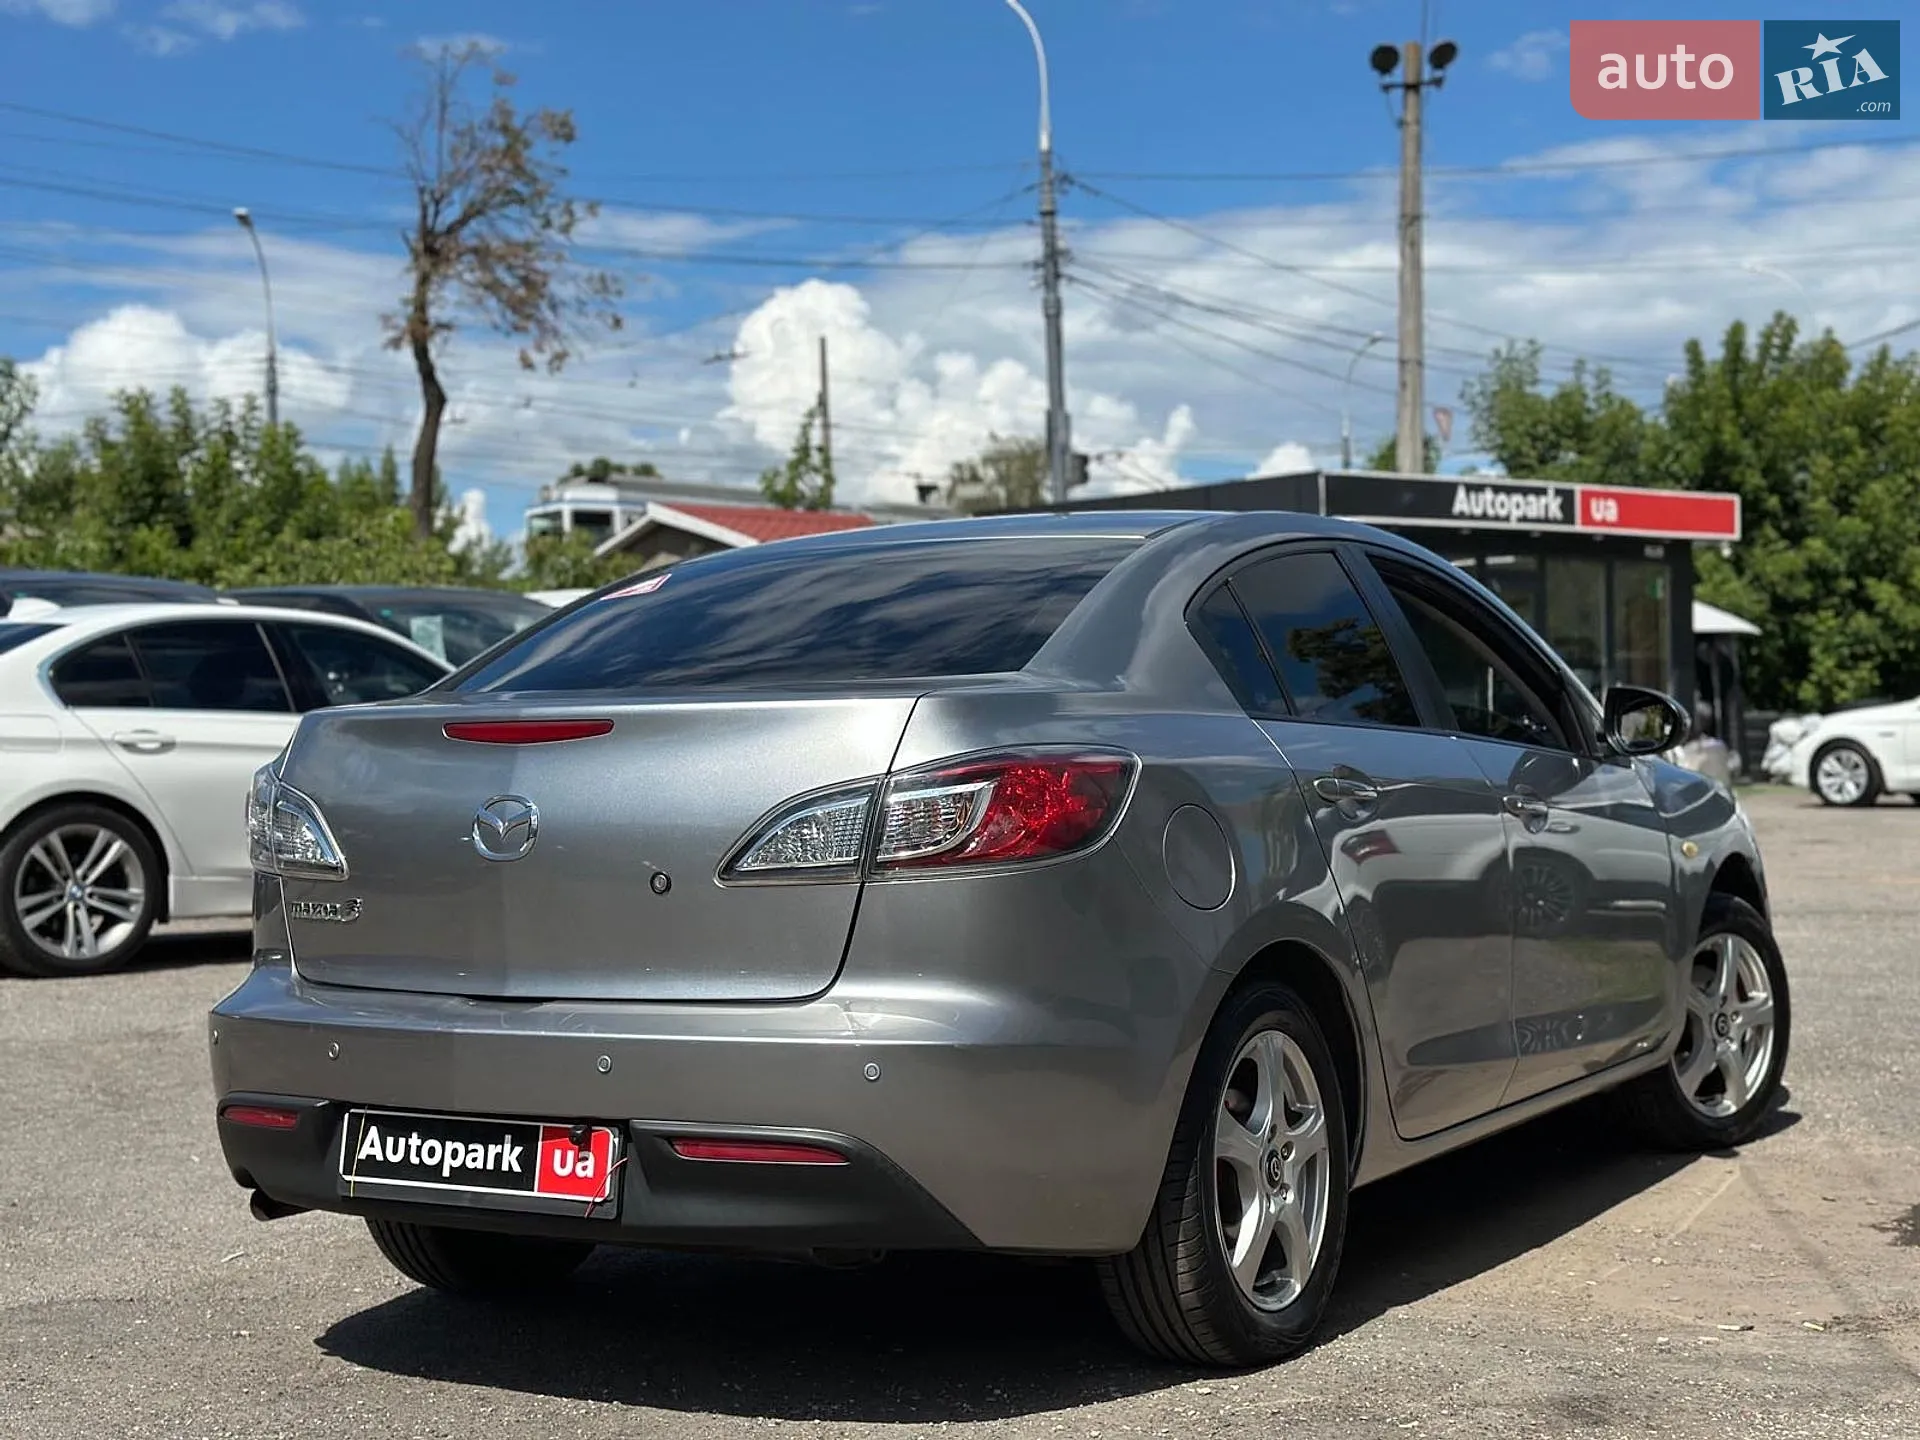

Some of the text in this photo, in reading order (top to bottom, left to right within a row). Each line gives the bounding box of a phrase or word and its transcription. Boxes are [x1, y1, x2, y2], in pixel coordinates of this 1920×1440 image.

[1452, 484, 1619, 524] Autopark ua
[357, 1125, 596, 1179] Autopark ua
